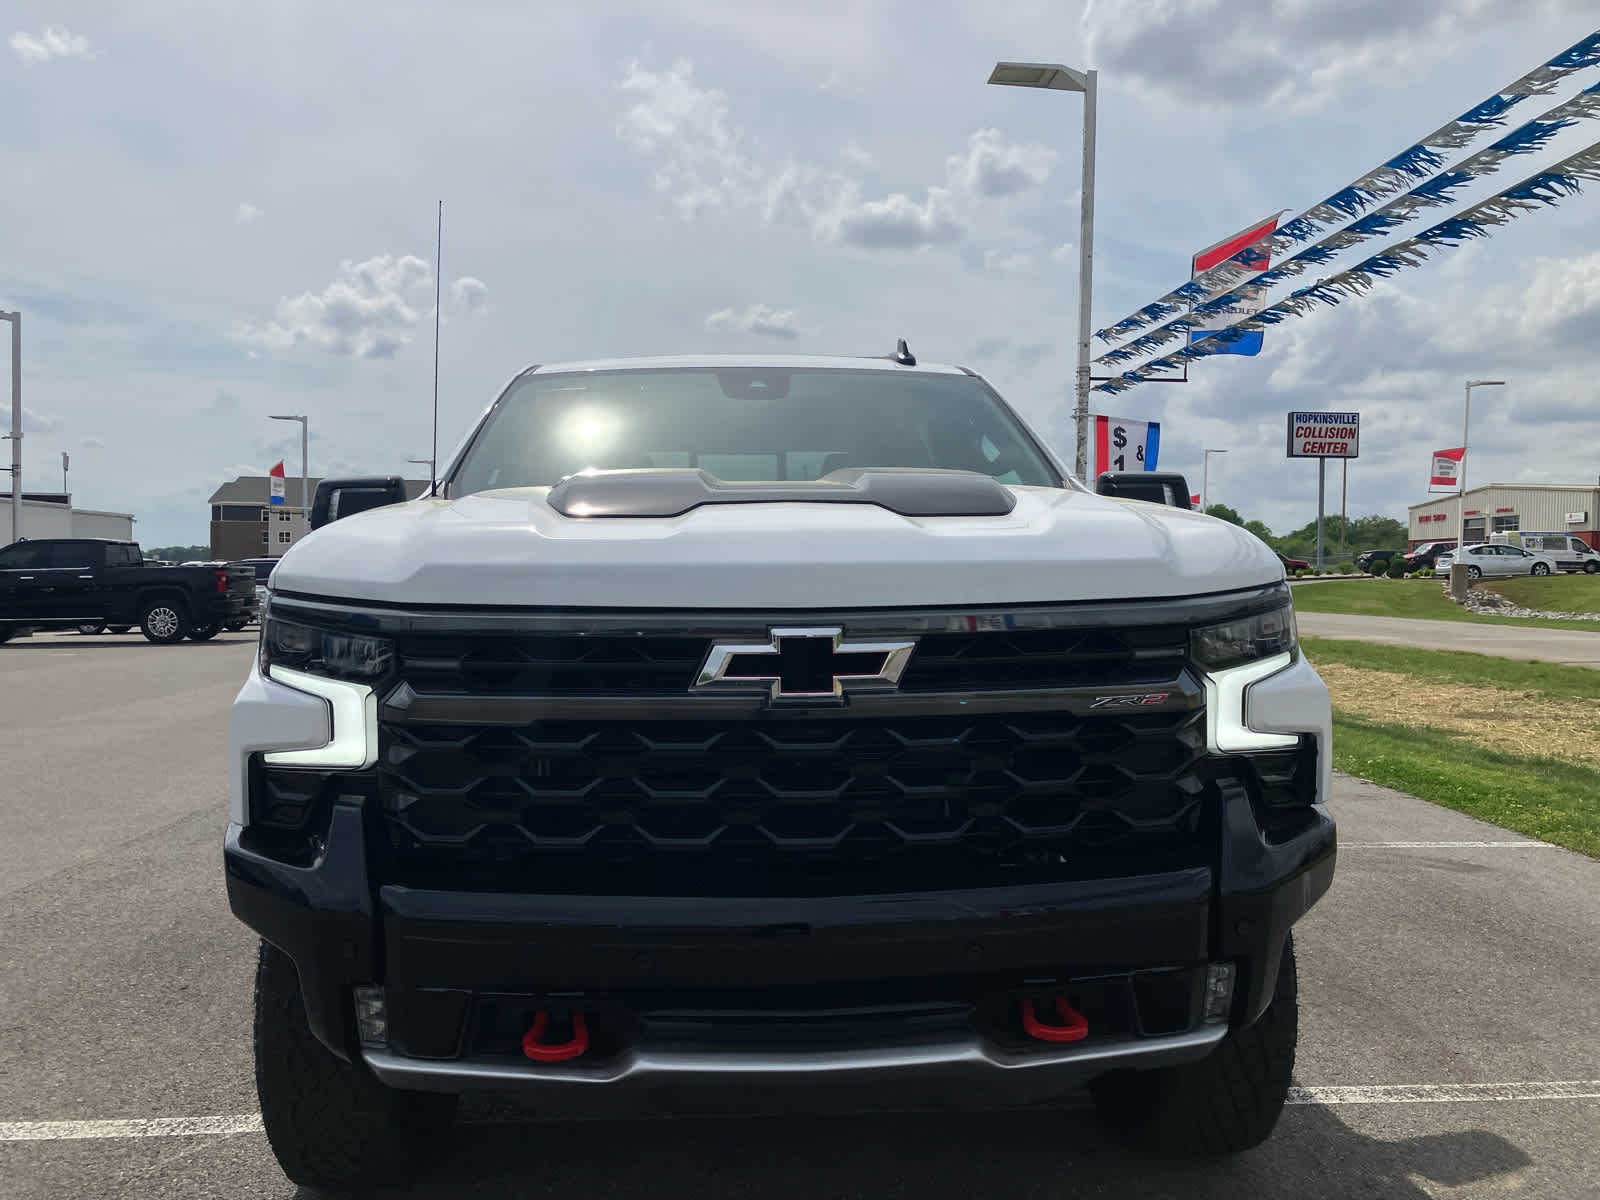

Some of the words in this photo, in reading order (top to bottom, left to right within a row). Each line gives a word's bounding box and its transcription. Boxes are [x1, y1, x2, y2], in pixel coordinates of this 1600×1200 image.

[1295, 413, 1357, 425] HOPKINSVILLE
[1295, 426, 1356, 440] COLLISION
[1302, 441, 1349, 455] CENTER
[1089, 693, 1168, 709] ZR2
